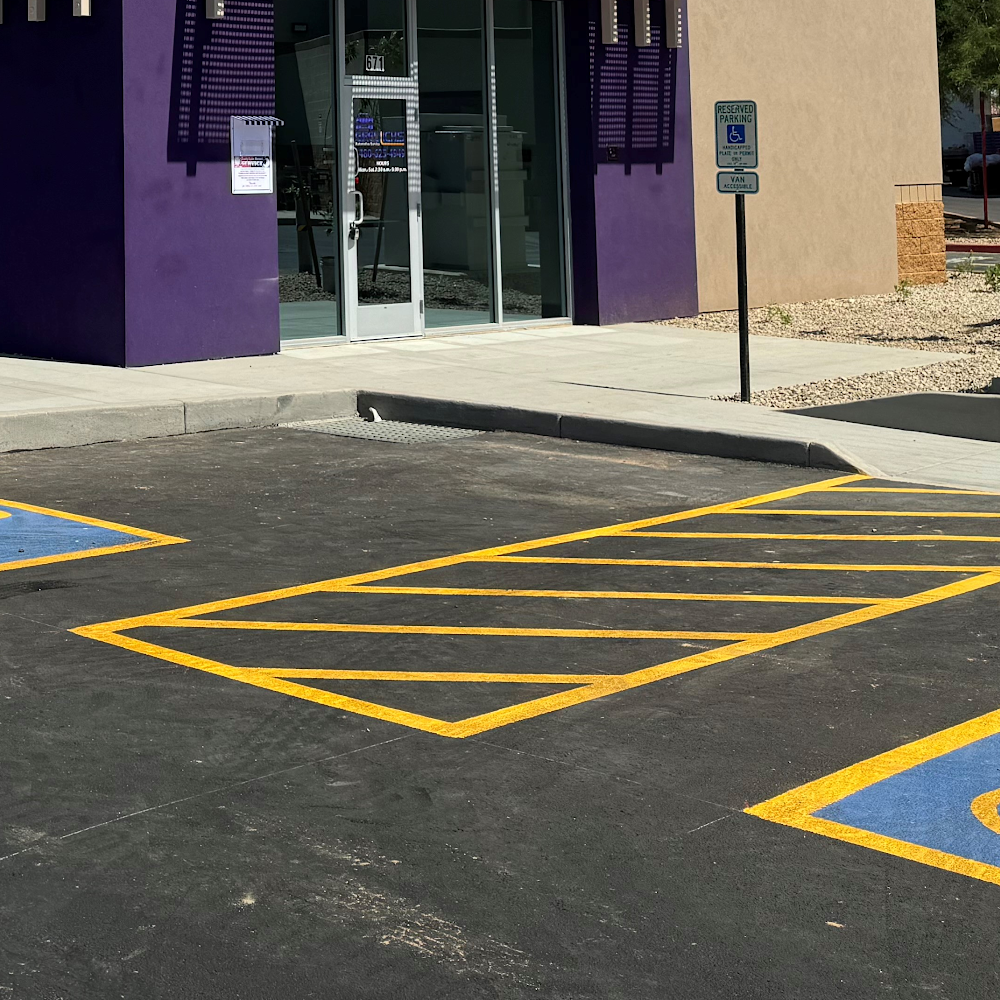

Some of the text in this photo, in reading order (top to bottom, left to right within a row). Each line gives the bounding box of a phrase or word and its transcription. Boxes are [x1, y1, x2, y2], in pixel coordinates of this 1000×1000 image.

[367, 55, 383, 71] 671
[717, 104, 753, 114] RESERVED
[720, 114, 752, 123] PARKING
